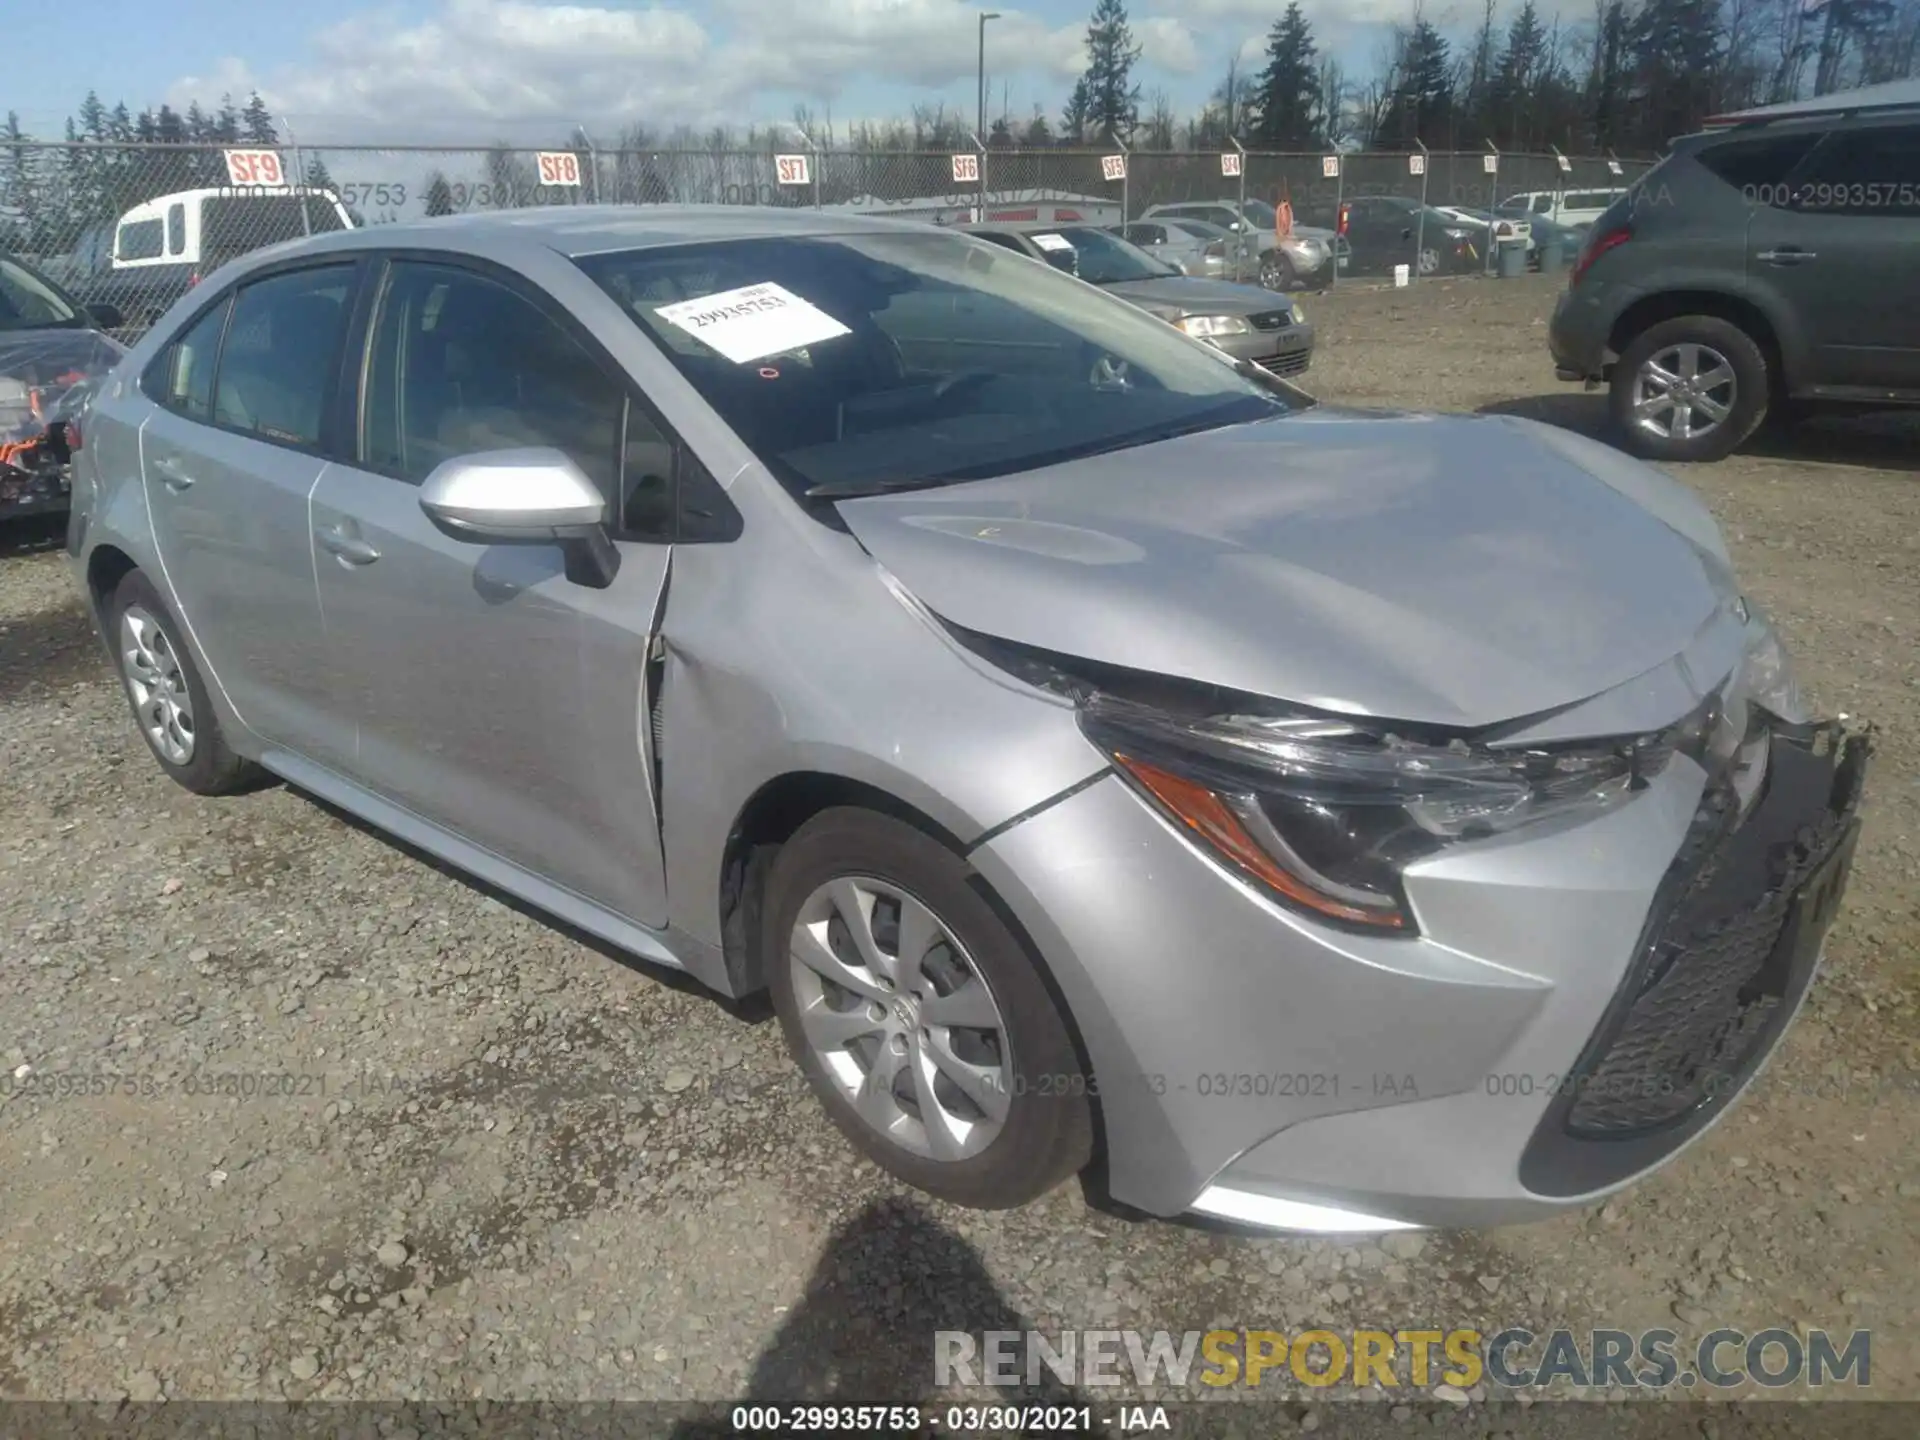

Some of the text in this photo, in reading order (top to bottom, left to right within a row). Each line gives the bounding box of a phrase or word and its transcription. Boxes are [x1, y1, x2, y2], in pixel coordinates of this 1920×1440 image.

[230, 153, 279, 182] SF9
[541, 156, 576, 182] SF8
[779, 158, 804, 181] SF7
[954, 158, 976, 178] SF6
[1104, 158, 1123, 178] SF5
